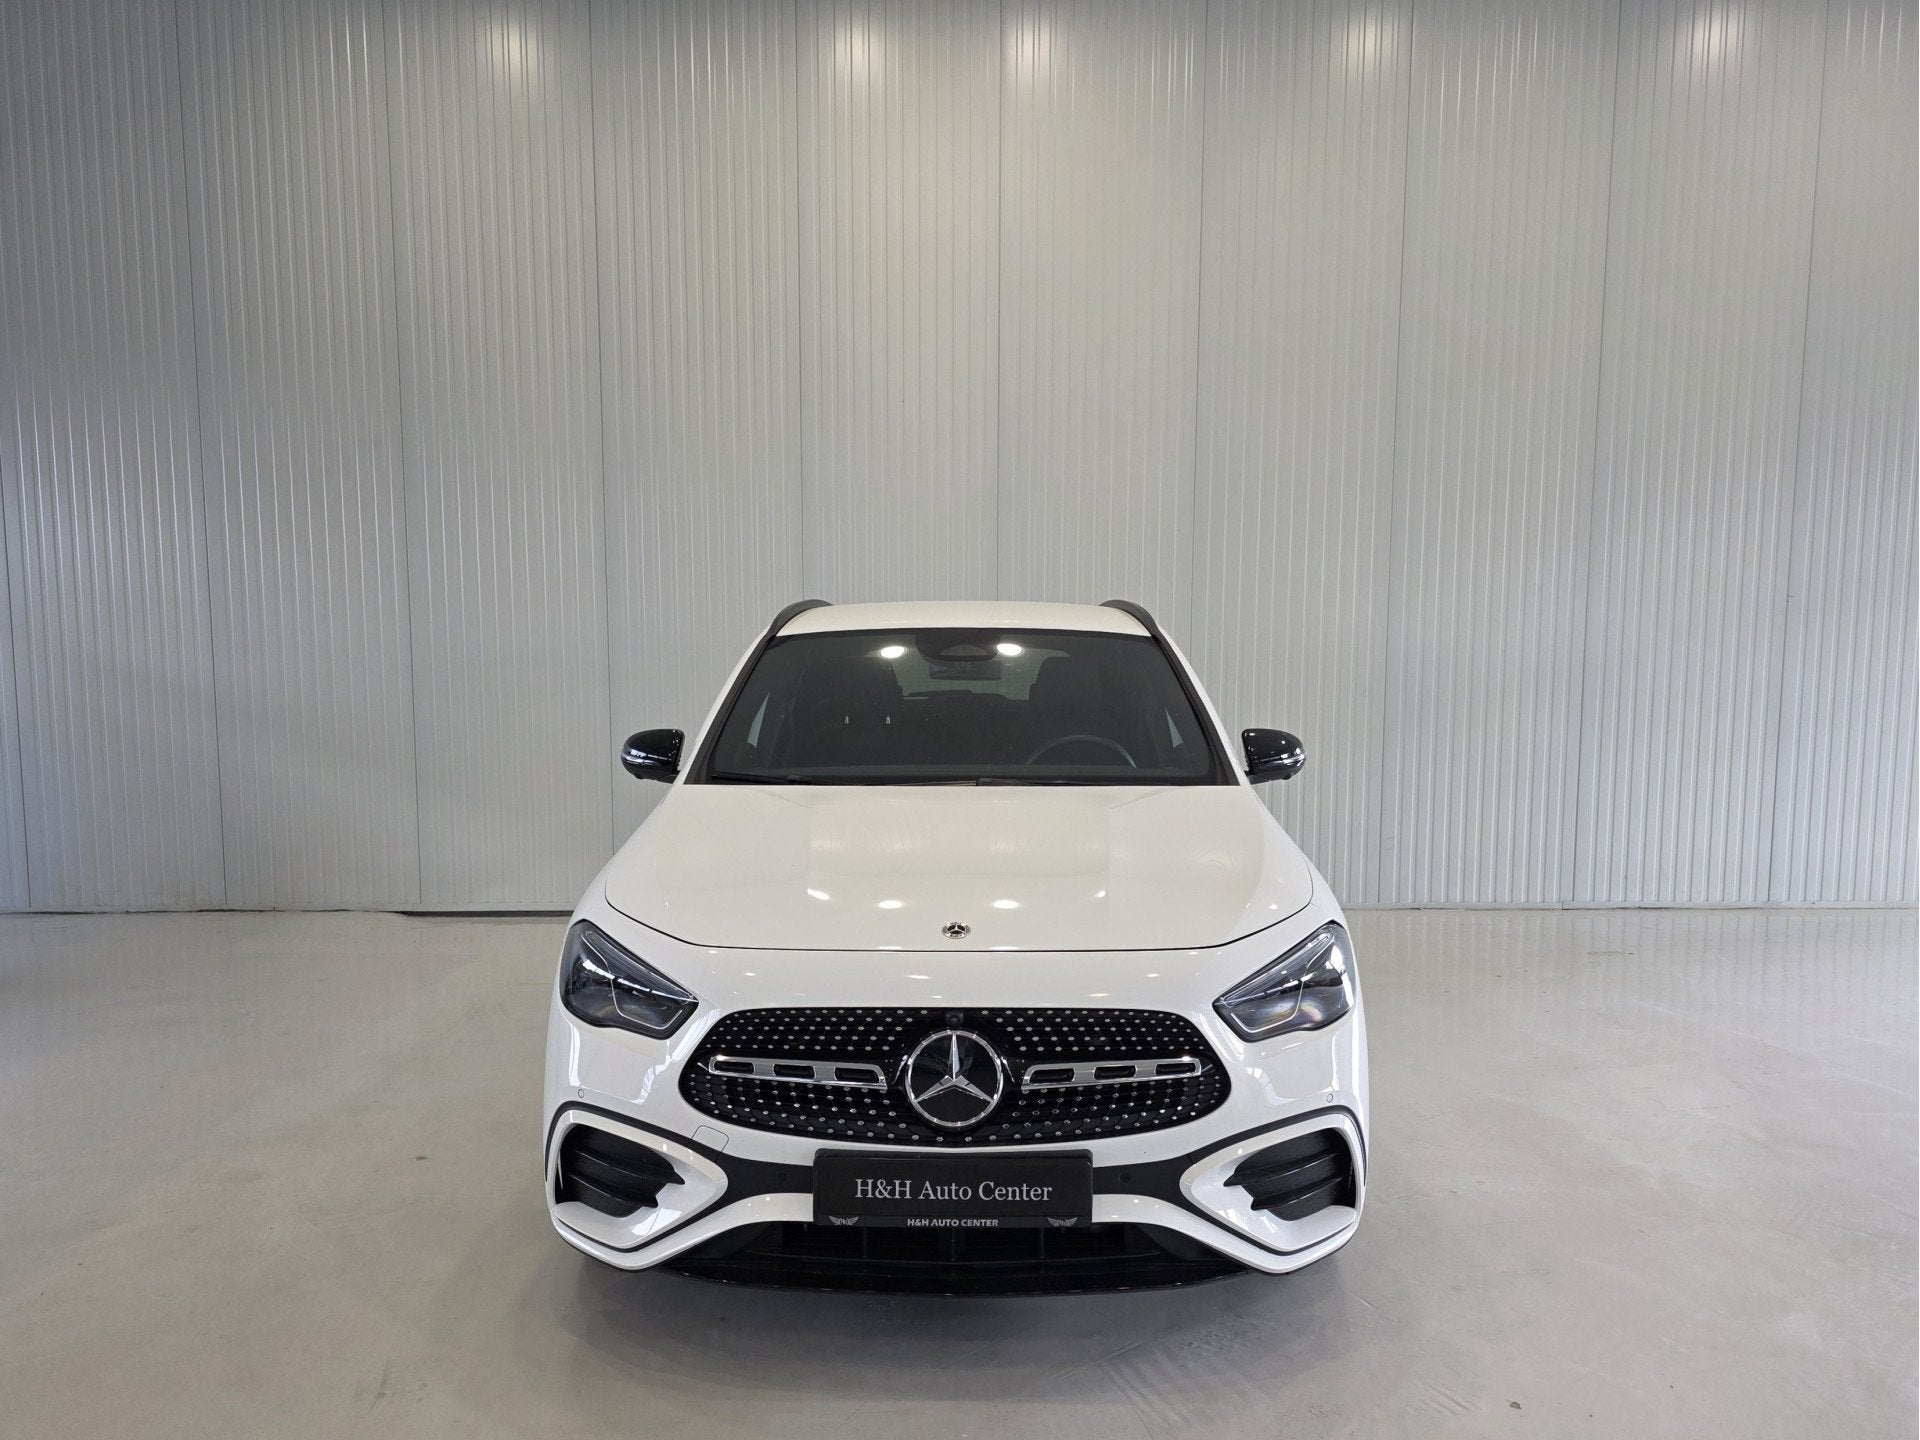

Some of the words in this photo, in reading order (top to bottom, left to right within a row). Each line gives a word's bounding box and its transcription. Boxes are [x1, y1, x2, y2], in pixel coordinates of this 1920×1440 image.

[855, 1179, 912, 1199] H&H
[918, 1180, 972, 1200] Auto
[978, 1182, 1053, 1201] Center
[907, 1218, 930, 1227] H&H
[930, 1218, 960, 1227] AUTO
[961, 1218, 999, 1227] CENTER
